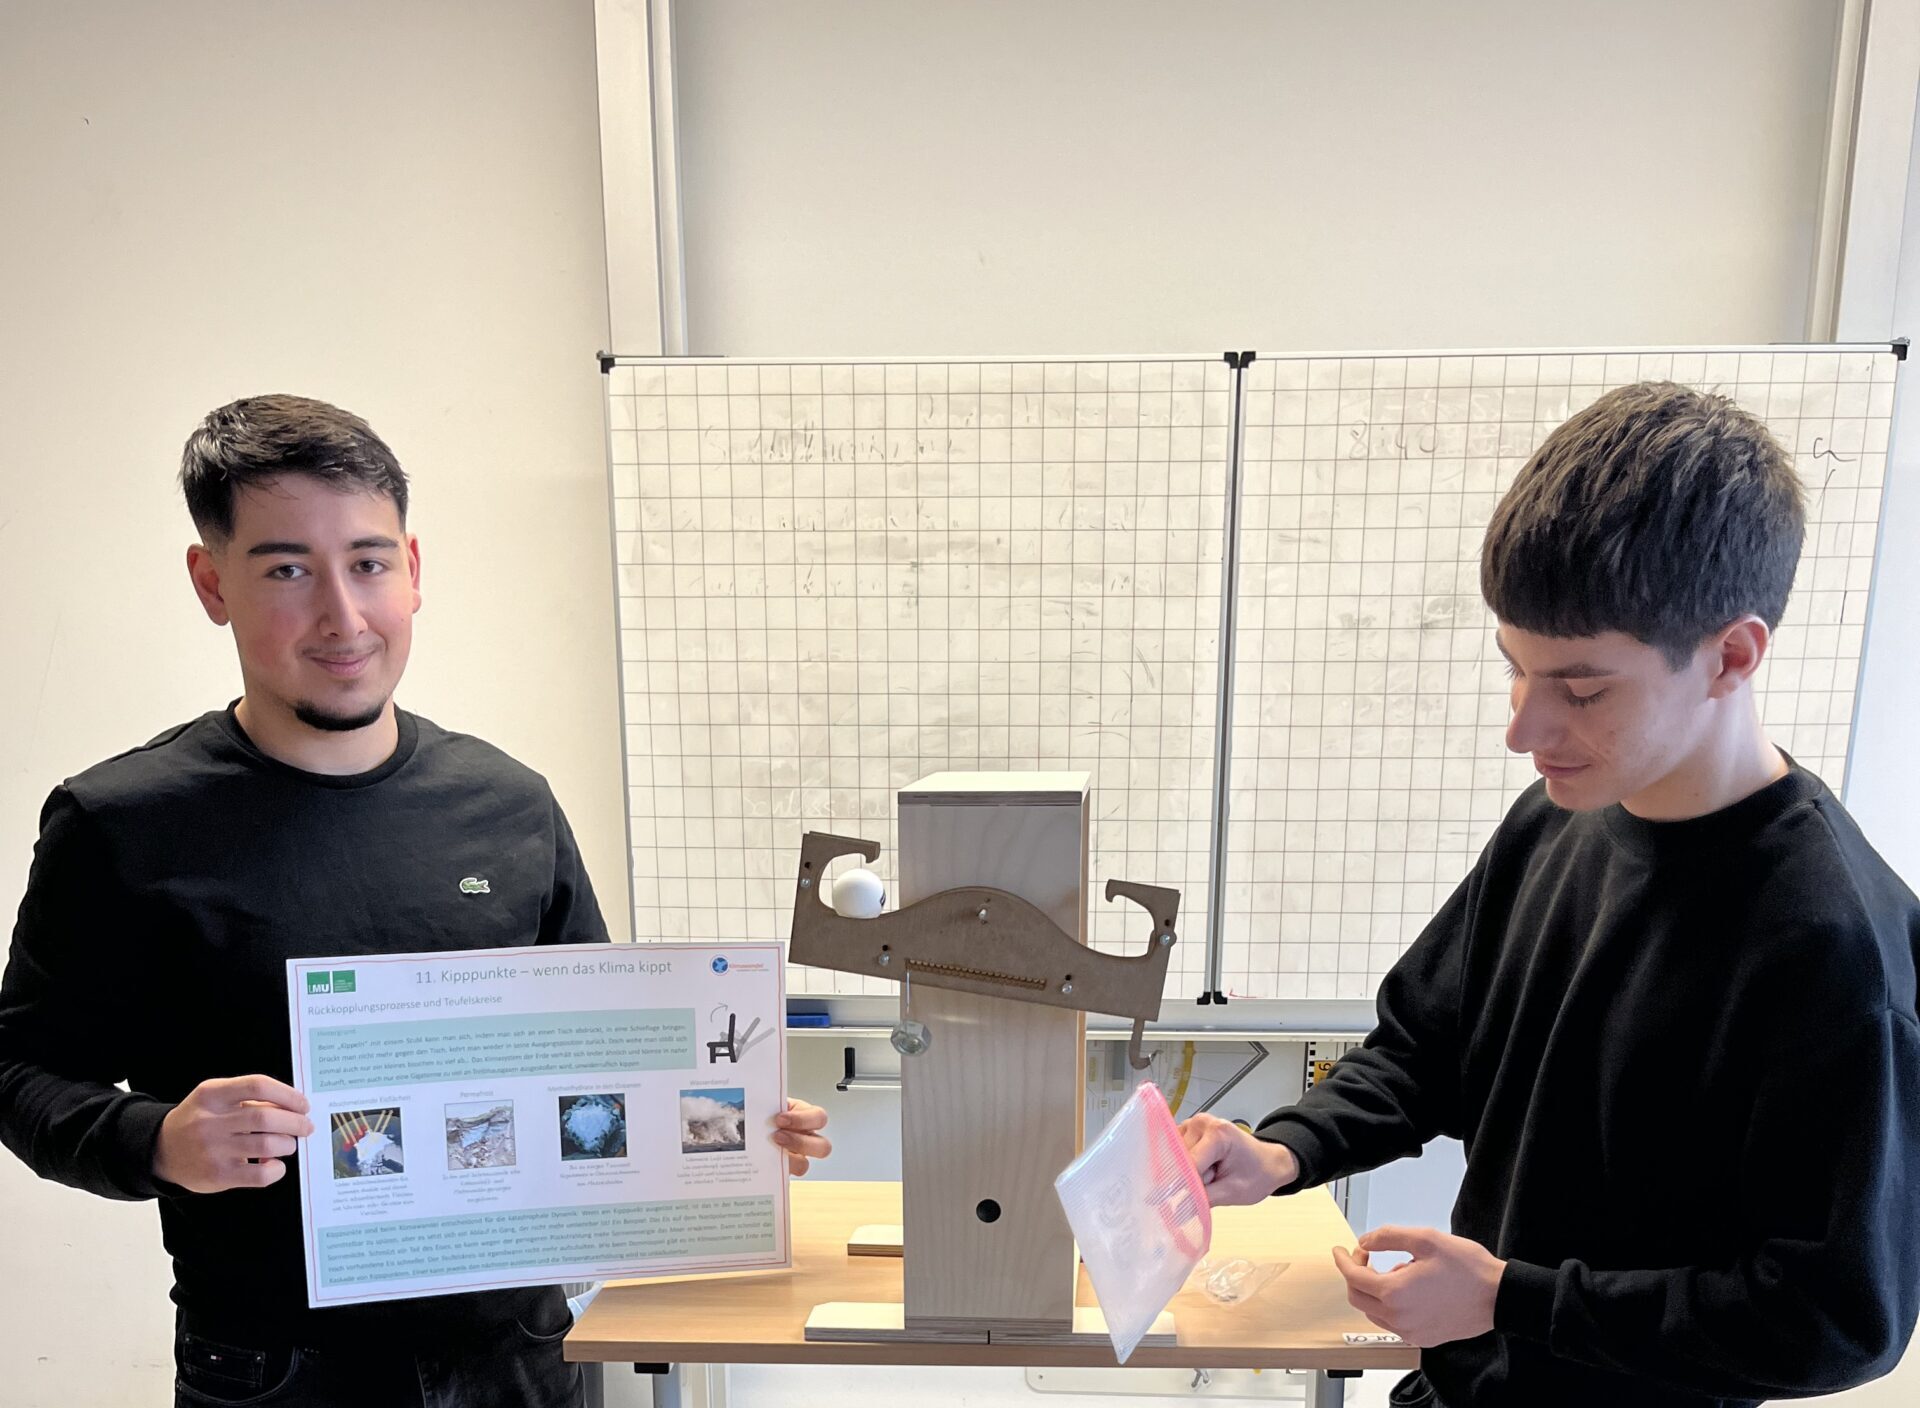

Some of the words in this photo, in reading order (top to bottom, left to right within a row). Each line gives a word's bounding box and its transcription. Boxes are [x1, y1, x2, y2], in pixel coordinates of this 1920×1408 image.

[416, 970, 436, 984] 11.
[441, 966, 517, 984] Kipppunkte
[533, 966, 568, 977] wenn
[572, 962, 596, 974] das
[599, 962, 635, 974] Klima
[639, 960, 672, 975] kippt
[308, 984, 330, 992] LMU
[308, 1002, 421, 1016] Rückkopplungsprozesse
[424, 1000, 442, 1008] und
[444, 995, 502, 1006] Teufelskreise
